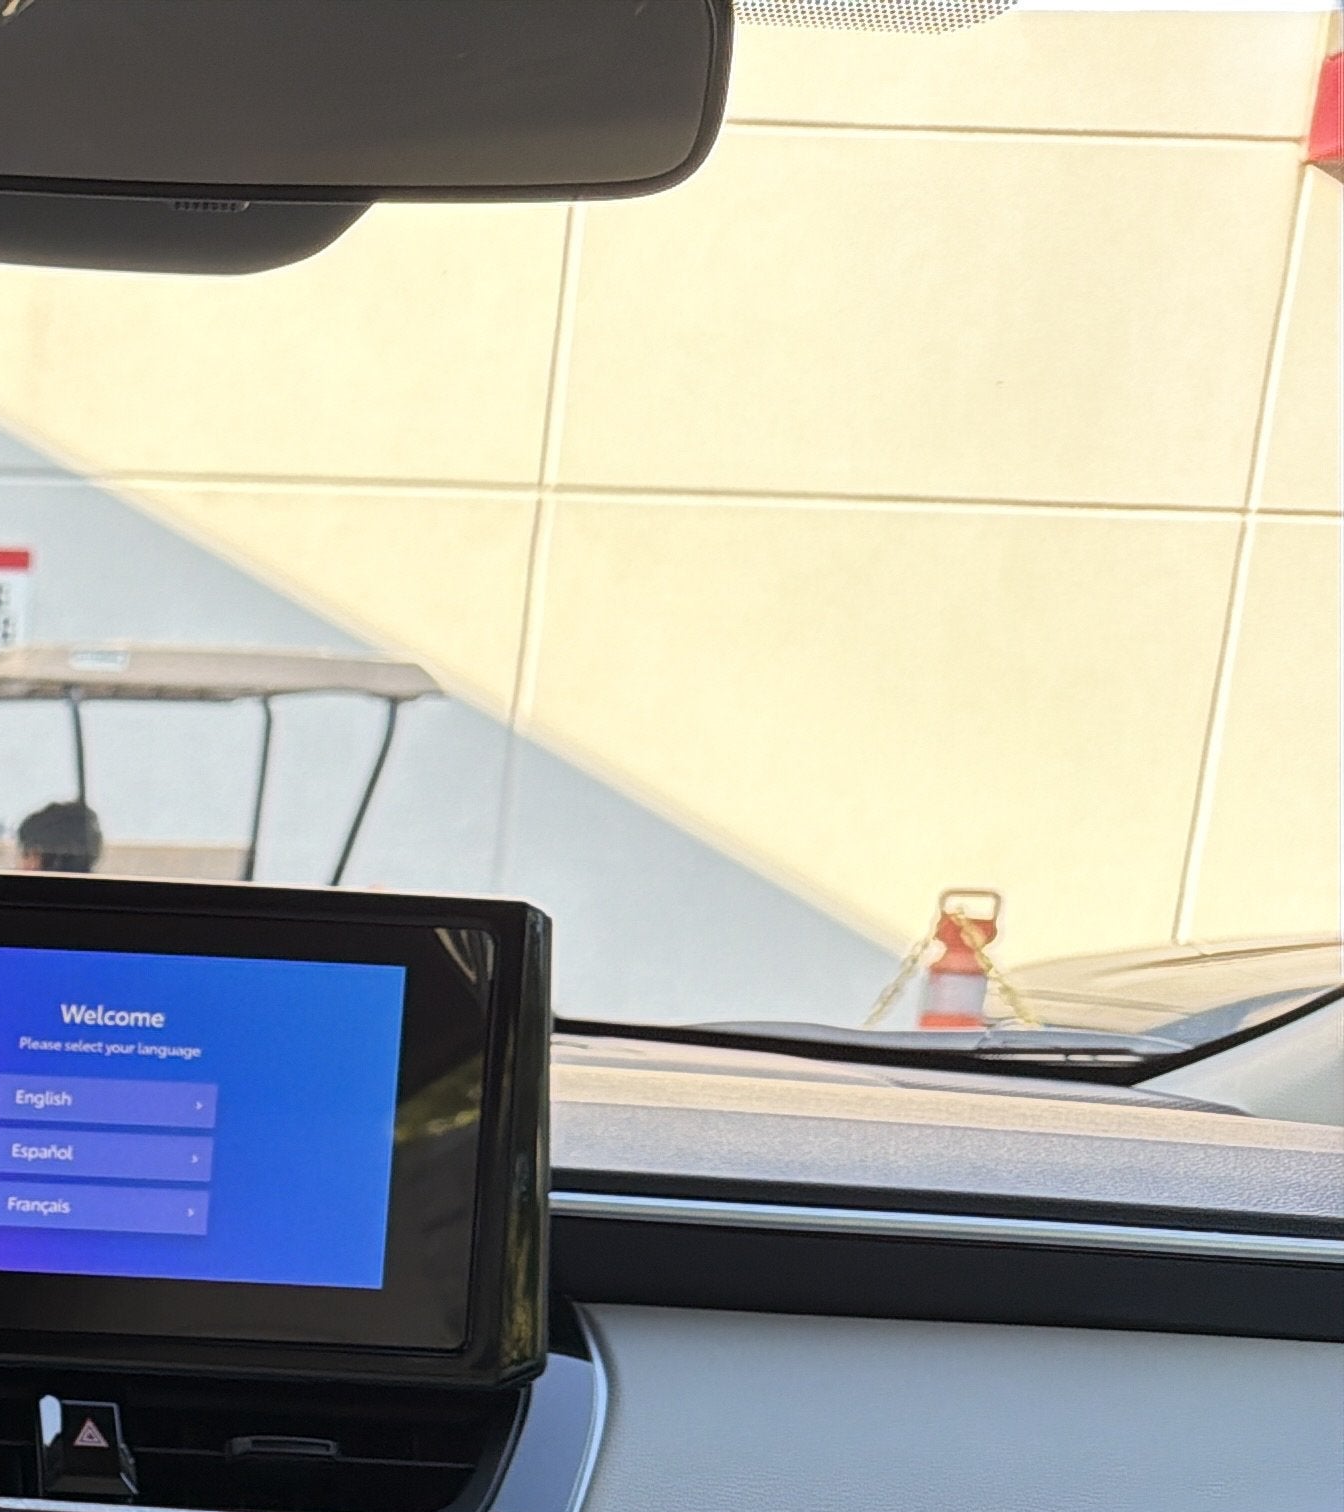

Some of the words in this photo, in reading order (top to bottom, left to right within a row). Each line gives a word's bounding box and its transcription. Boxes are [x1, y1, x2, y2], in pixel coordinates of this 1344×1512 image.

[60, 1003, 166, 1029] Welcome
[19, 1035, 62, 1052] Please
[64, 1039, 104, 1055] select
[105, 1043, 136, 1057] your
[137, 1042, 202, 1061] language
[14, 1089, 73, 1110] English
[11, 1142, 74, 1161] Español
[7, 1196, 71, 1216] Français
